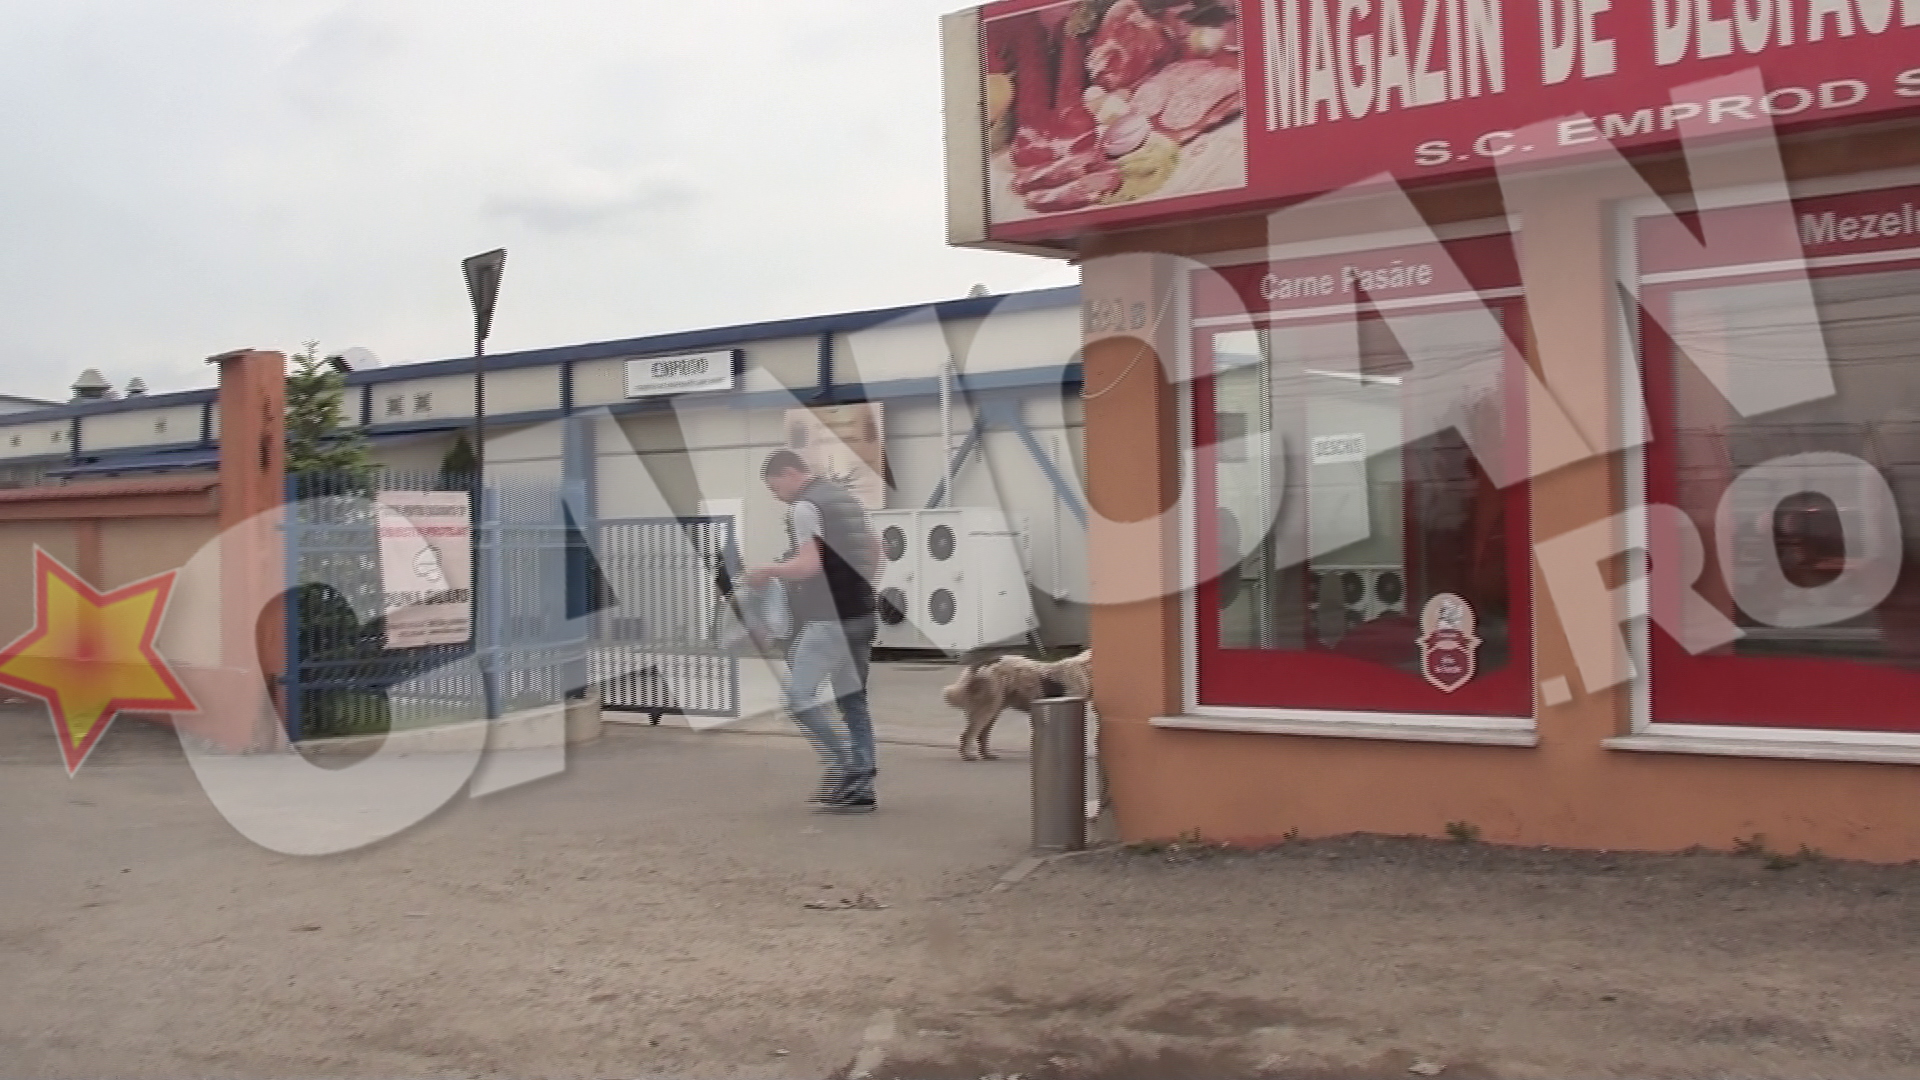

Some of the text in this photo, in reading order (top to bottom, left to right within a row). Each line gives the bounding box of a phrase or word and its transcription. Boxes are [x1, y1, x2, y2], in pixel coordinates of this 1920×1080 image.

[1261, 0, 1505, 131] MAGAZIN
[1414, 128, 1535, 167] S.C.
[1556, 79, 1871, 147] EMPROD
[1801, 202, 1920, 244] Mezel
[1260, 273, 1335, 300] Carne
[651, 357, 709, 377] EMPROD
[1315, 438, 1363, 456] DESCHIS
[424, 588, 470, 606] GUARD
